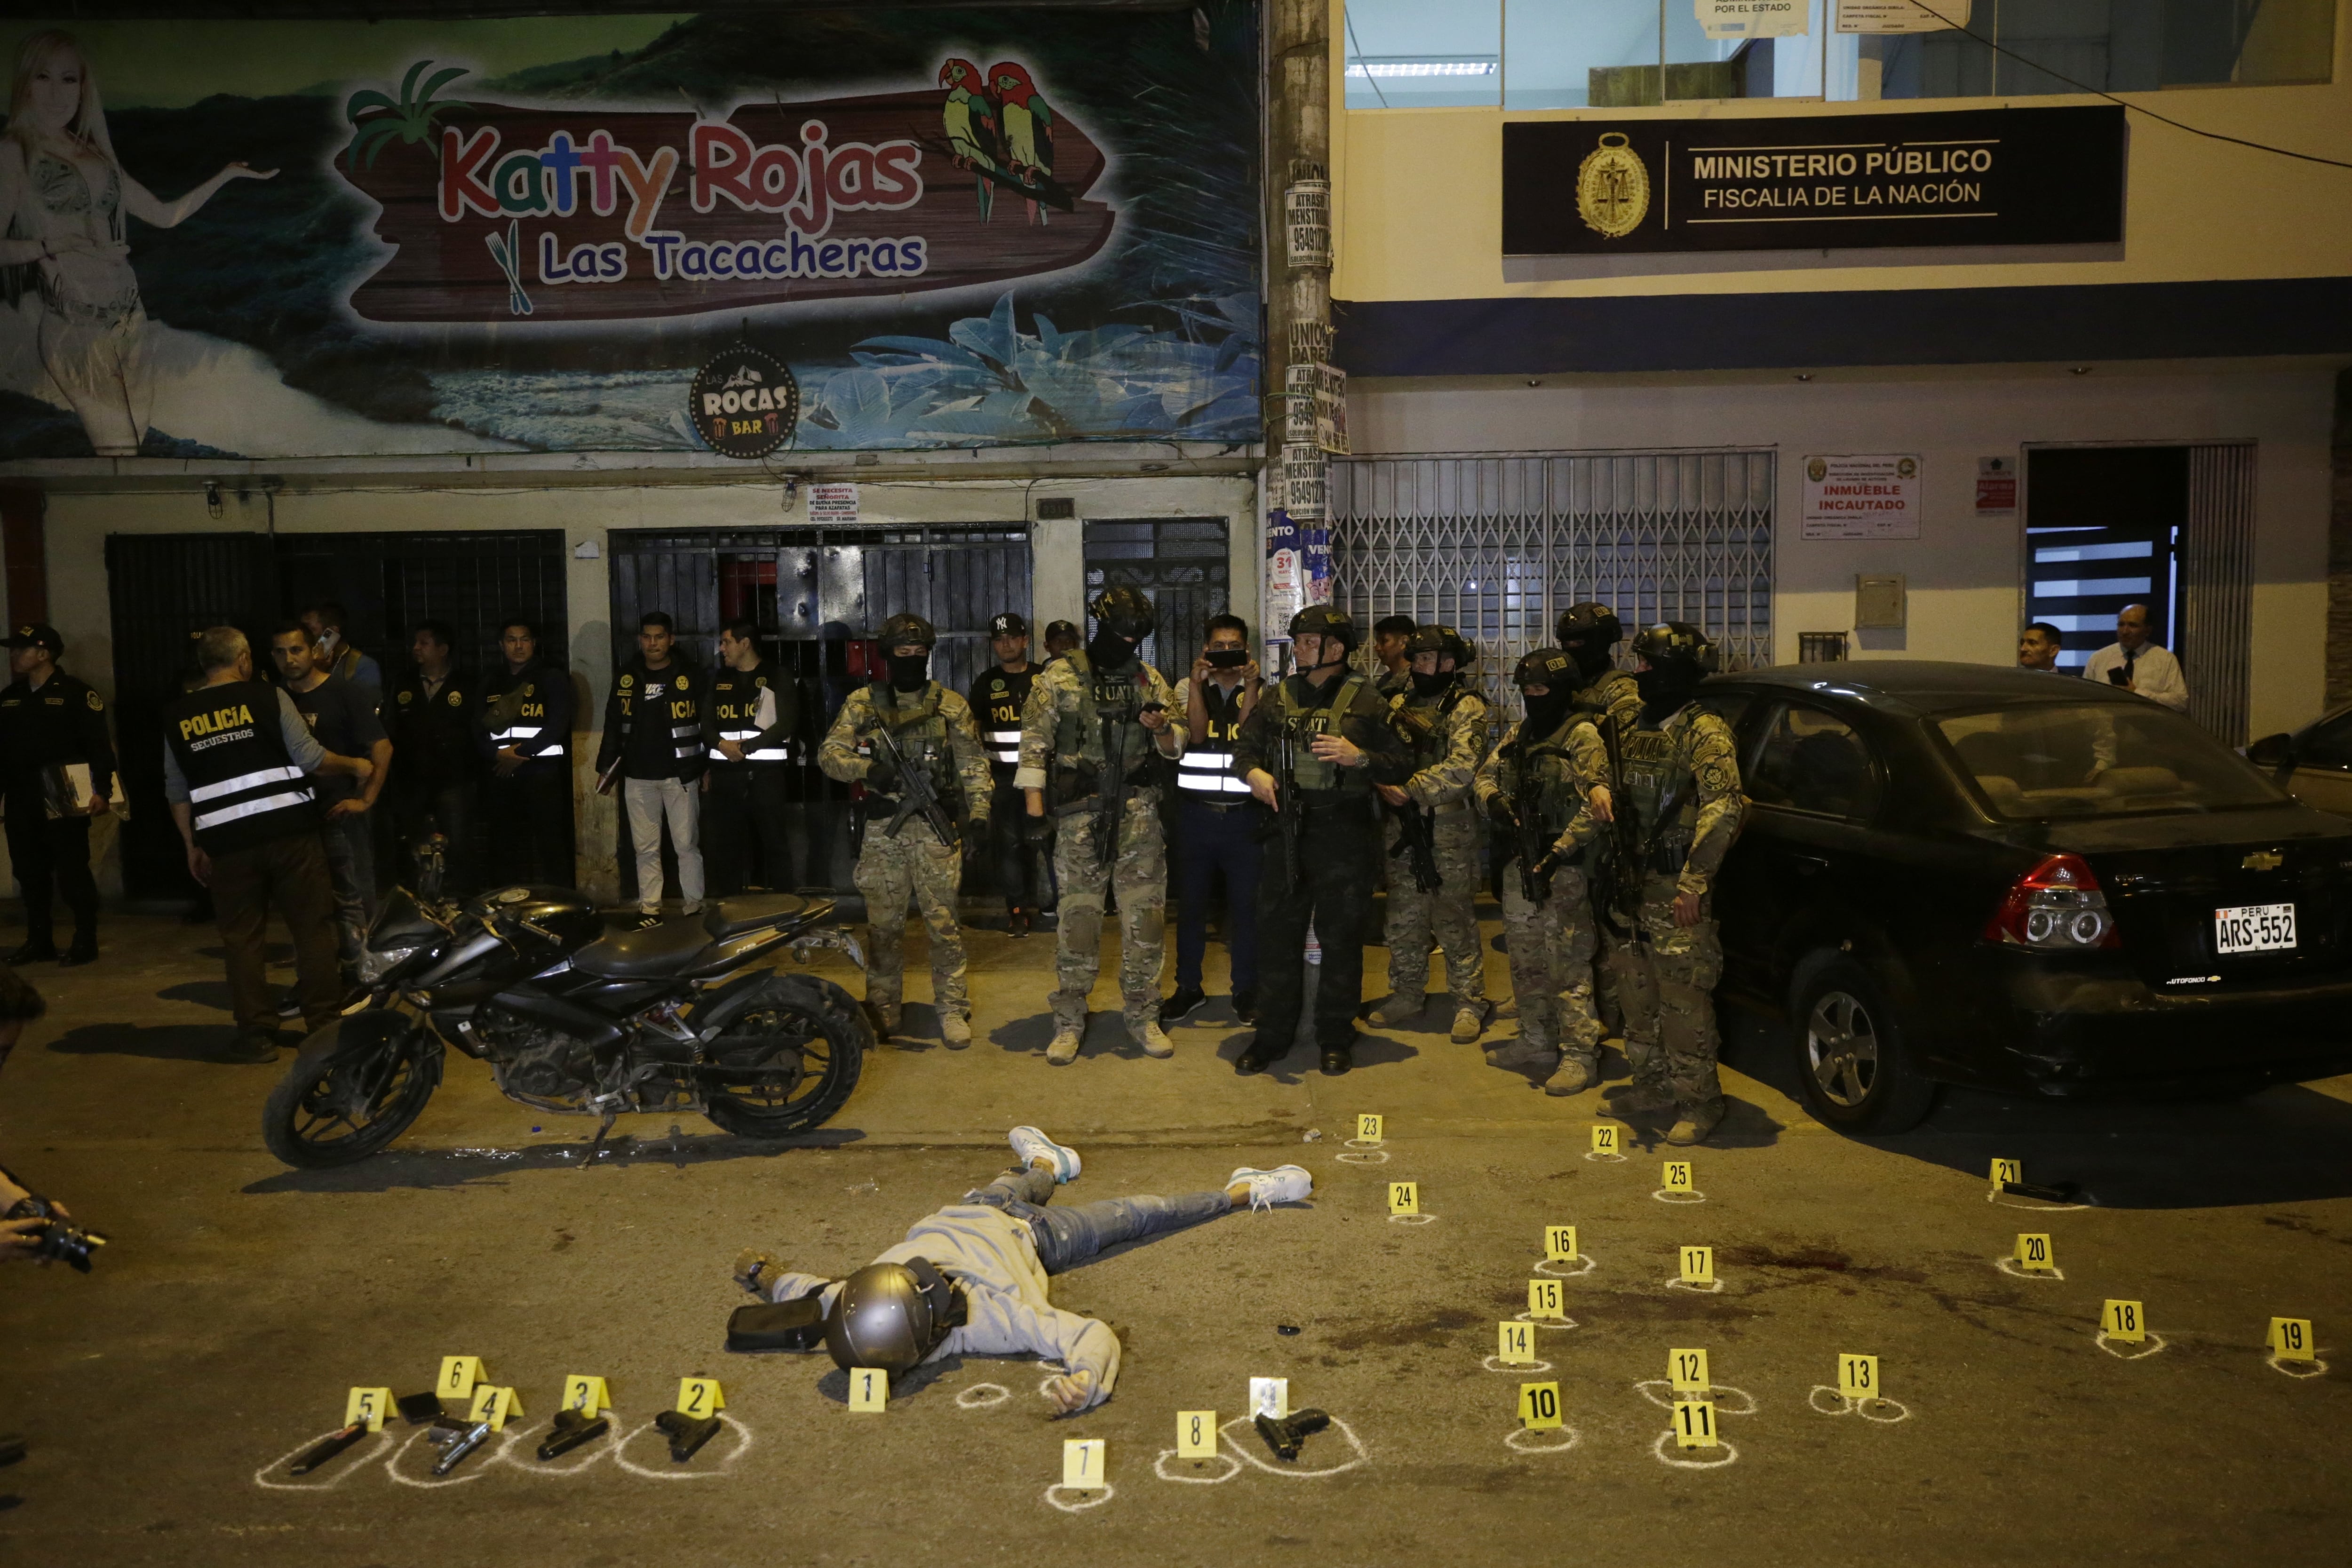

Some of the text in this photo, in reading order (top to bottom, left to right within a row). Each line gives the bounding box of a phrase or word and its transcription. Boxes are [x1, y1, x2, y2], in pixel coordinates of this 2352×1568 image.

[1753, 3, 1791, 12] ESTADO
[1694, 146, 1992, 180] MINISTERIO PÚBLICO
[440, 120, 921, 233] Katty Rojas
[1296, 194, 1325, 208] ATRASO
[1704, 181, 1980, 208] FISCALIA DE LA NACIÓN
[544, 234, 923, 281] Las Tacacheras
[706, 374, 723, 385] LAS
[702, 386, 787, 416] ROCAS
[731, 420, 763, 436] BAR
[1823, 485, 1901, 495] INMUEBLE
[1819, 500, 1906, 510] INCAUTADO
[1277, 556, 1292, 569] 31
[991, 705, 1020, 724] POL
[190, 728, 254, 752] SECUESTROS
[2241, 906, 2269, 917] PERU
[2220, 915, 2294, 948] ARS-552
[1363, 1117, 1377, 1136] 23
[1598, 1129, 1612, 1147] 22
[1670, 1165, 1686, 1185] 25
[1999, 1162, 2015, 1183] 21
[1396, 1186, 1412, 1206] 24
[1553, 1230, 1570, 1253] 16
[2026, 1237, 2045, 1261] 20
[1687, 1250, 1705, 1274] 17
[1537, 1284, 1556, 1309] 15
[2114, 1305, 2135, 1331] 18
[1507, 1327, 1526, 1353] 14
[2281, 1322, 2302, 1350] 19
[450, 1361, 463, 1389] 6
[1679, 1354, 1700, 1381] 12
[1848, 1360, 1870, 1388] 13
[573, 1382, 588, 1410] 3
[687, 1384, 705, 1412] 2
[863, 1373, 872, 1402] 1
[357, 1393, 373, 1419] 5
[482, 1392, 497, 1420] 4
[1527, 1389, 1556, 1419] 10
[1191, 1416, 1201, 1446] 8
[1680, 1405, 1709, 1436] 11
[1080, 1446, 1089, 1475] 7
